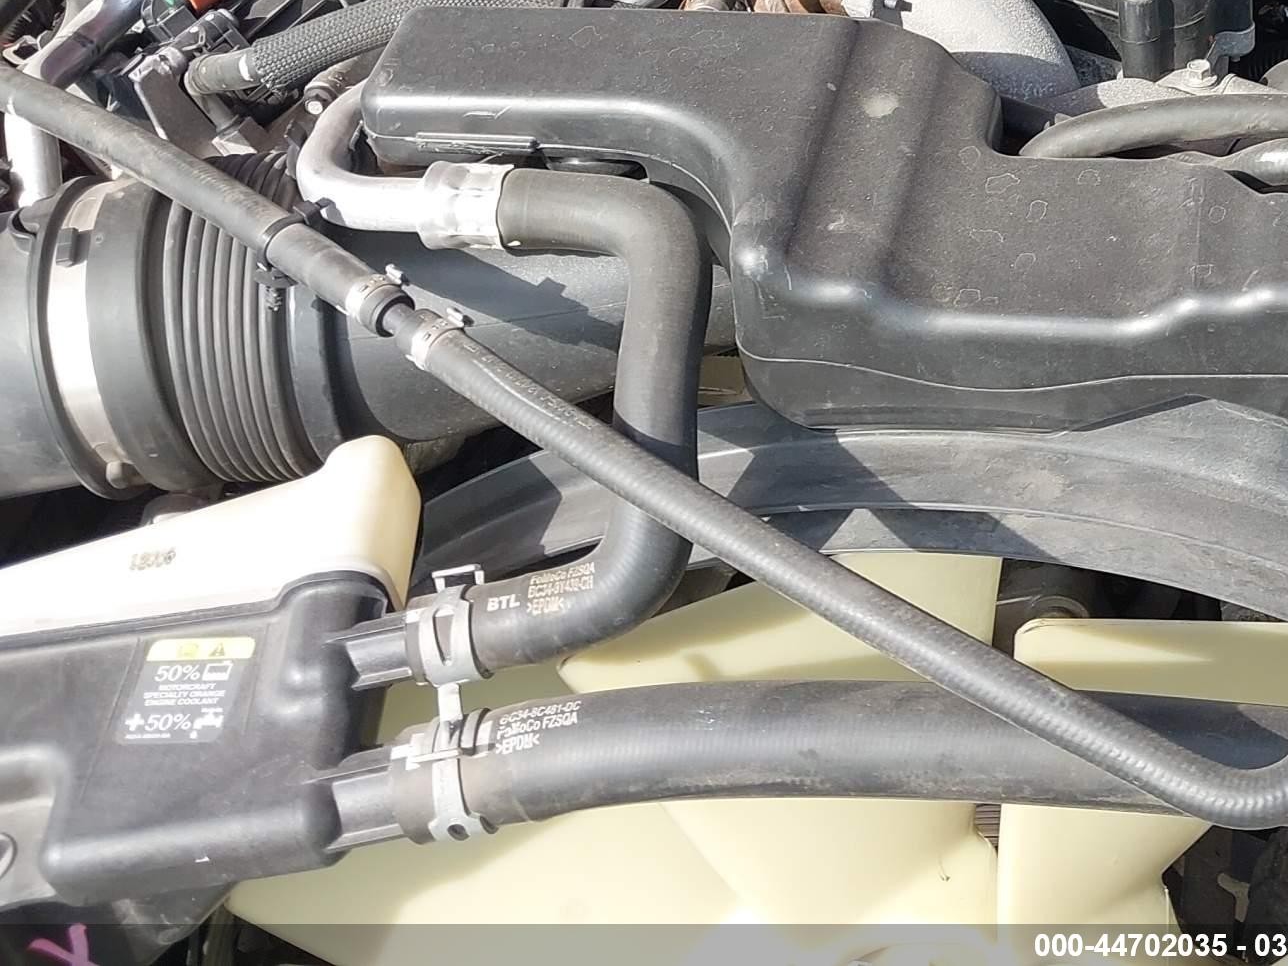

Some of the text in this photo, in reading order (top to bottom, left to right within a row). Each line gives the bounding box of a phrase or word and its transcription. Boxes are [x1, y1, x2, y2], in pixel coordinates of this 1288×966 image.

[487, 596, 520, 611] BTL
[154, 664, 201, 682] 50%
[158, 682, 217, 691] MOTORCRAFT
[143, 689, 226, 699] SPECIALTY ORANGE
[144, 697, 220, 706] ENGINE COOLANT
